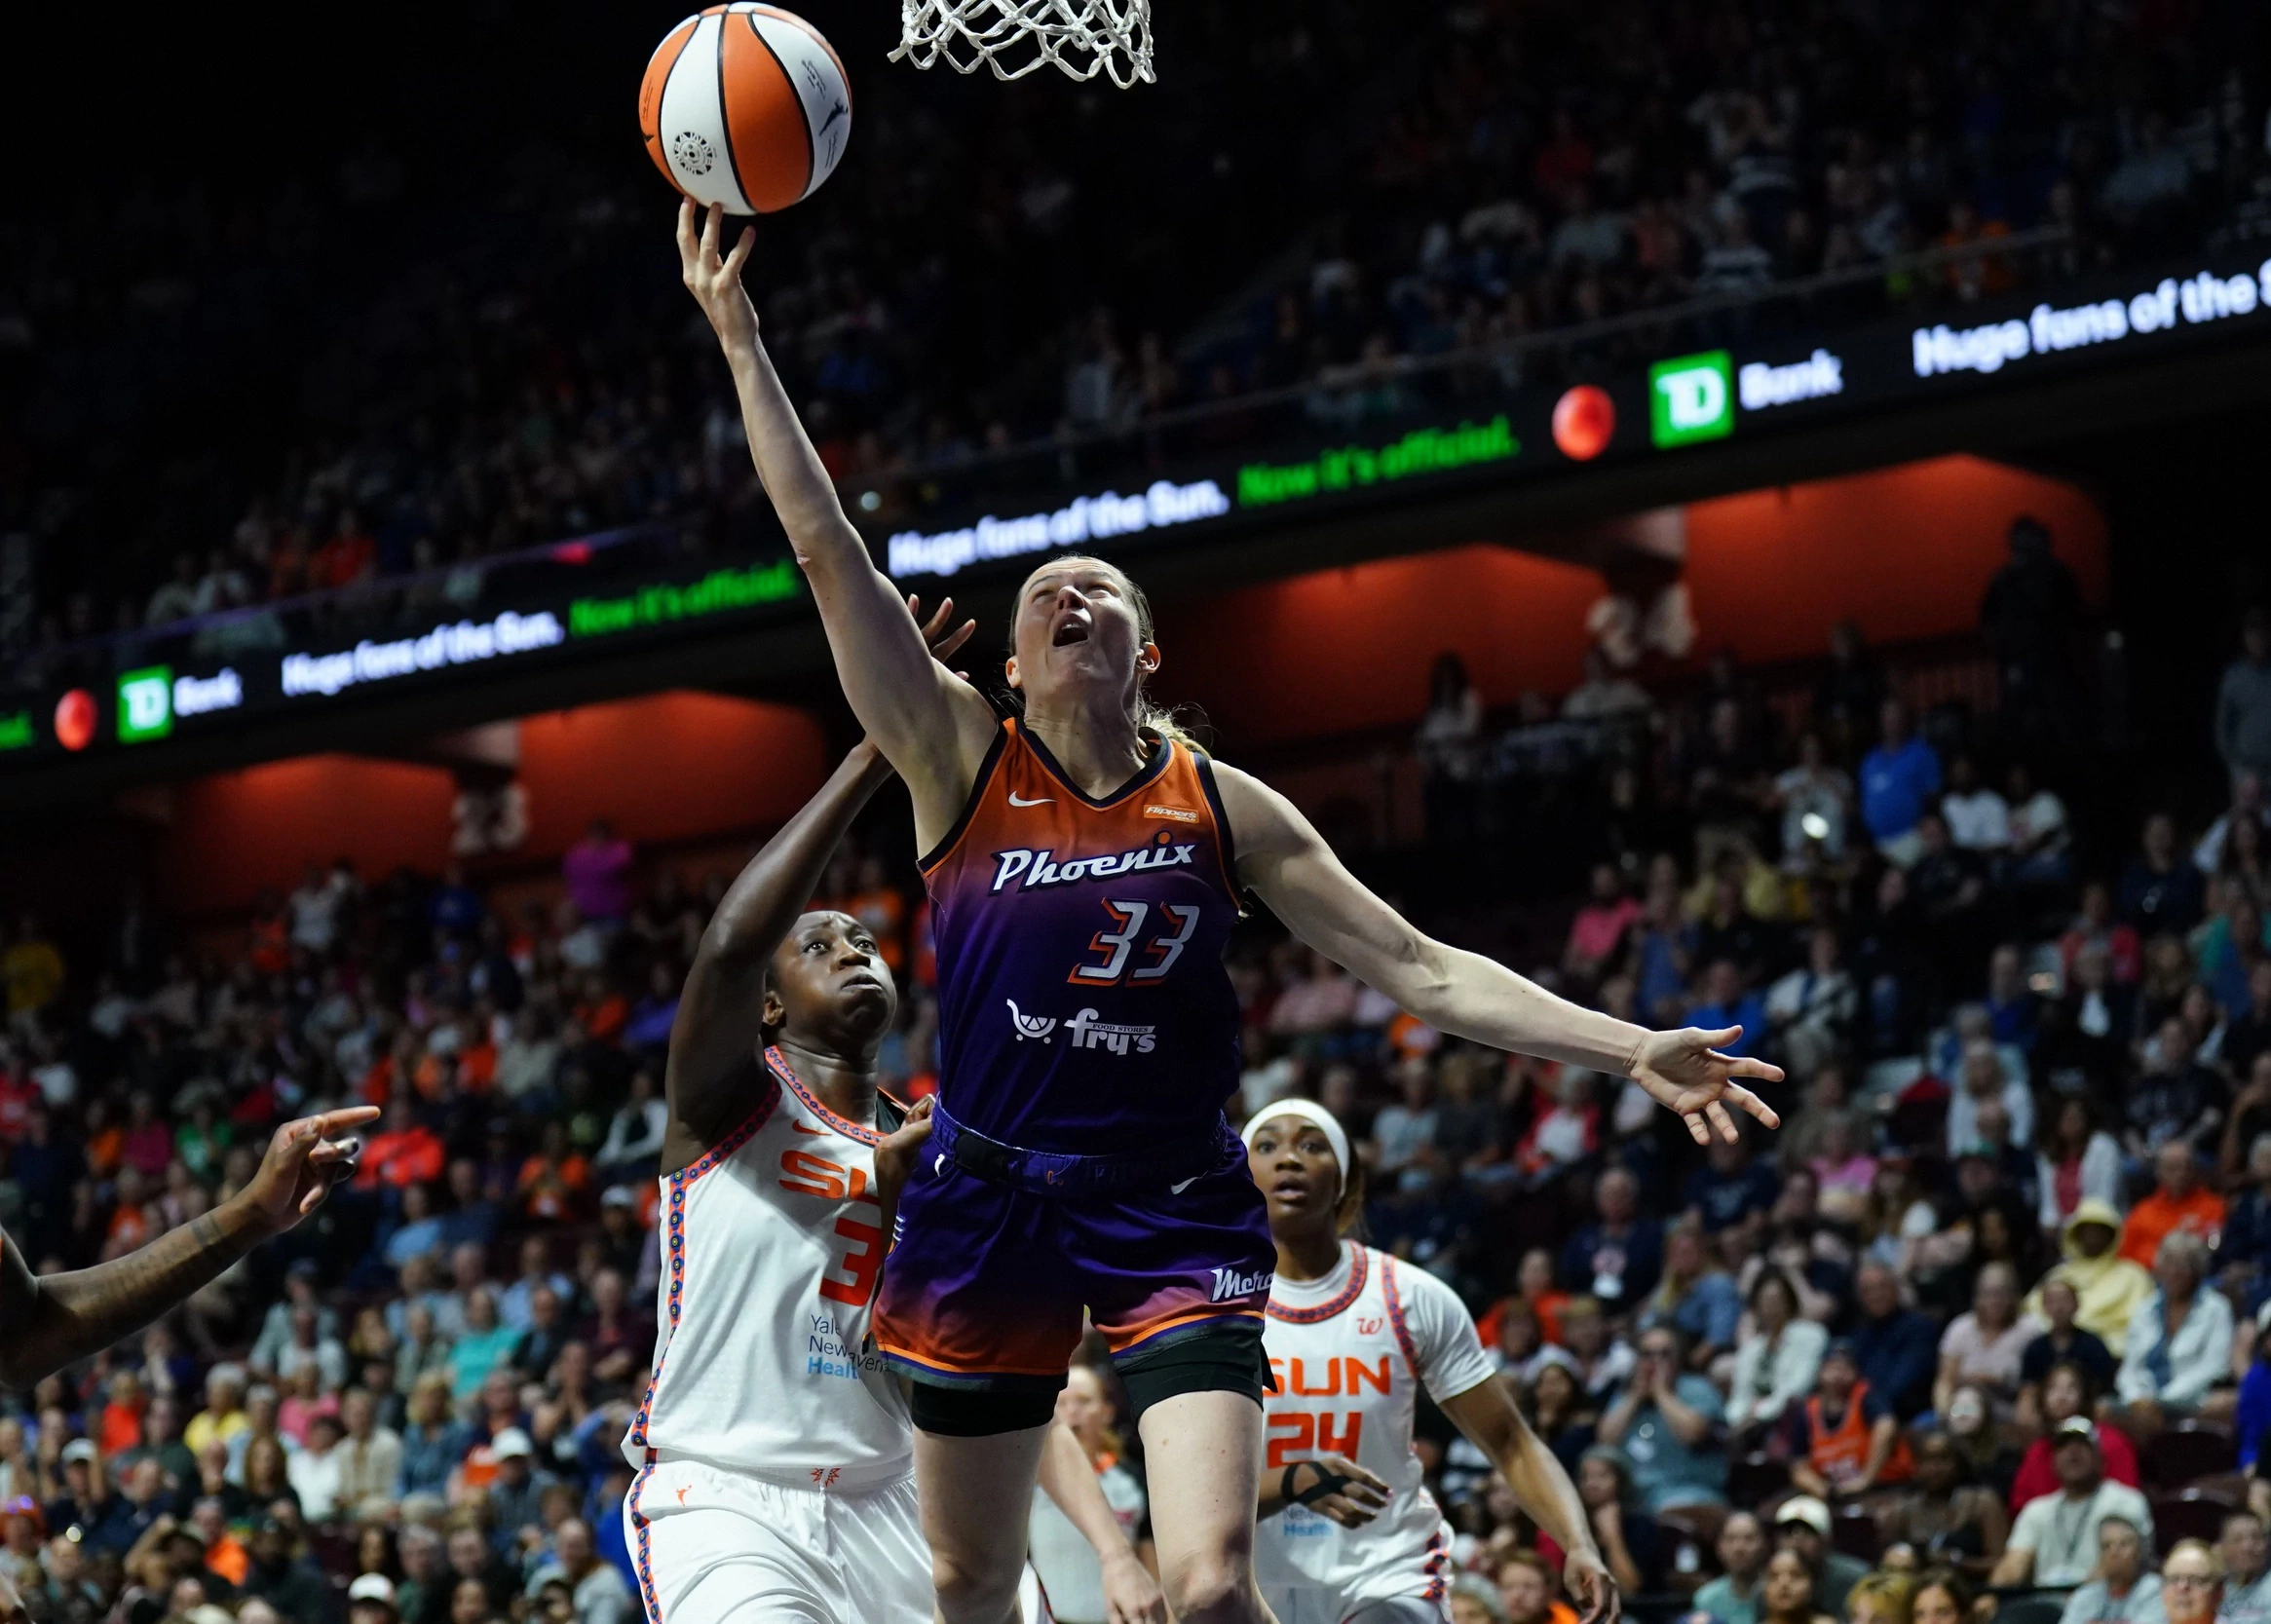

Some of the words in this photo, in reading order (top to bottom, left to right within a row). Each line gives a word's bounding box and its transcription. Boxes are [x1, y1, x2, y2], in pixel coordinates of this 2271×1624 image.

[1912, 319, 2029, 378] Huge
[2029, 299, 2128, 354] fans
[2129, 277, 2179, 333] of
[2179, 270, 2257, 323] the
[1655, 366, 1726, 430] TD
[1739, 348, 1843, 411] Bank
[888, 527, 976, 578] Huge
[976, 514, 1051, 562] fans
[1049, 496, 1088, 546] of
[1086, 489, 1148, 540] the
[282, 652, 355, 697] Huge
[354, 639, 417, 682] fans
[415, 623, 447, 670] of
[445, 619, 496, 664] the
[120, 677, 170, 732] TD
[173, 666, 243, 717] Bank
[990, 831, 1196, 893] Phoenix
[1067, 897, 1200, 987] 33
[1064, 1007, 1156, 1056] fry's
[1092, 1023, 1116, 1032] FOOD
[819, 1217, 881, 1307] 3
[1210, 1267, 1274, 1303] Merc
[808, 1356, 861, 1380] Healt
[1268, 1411, 1362, 1469] 24
